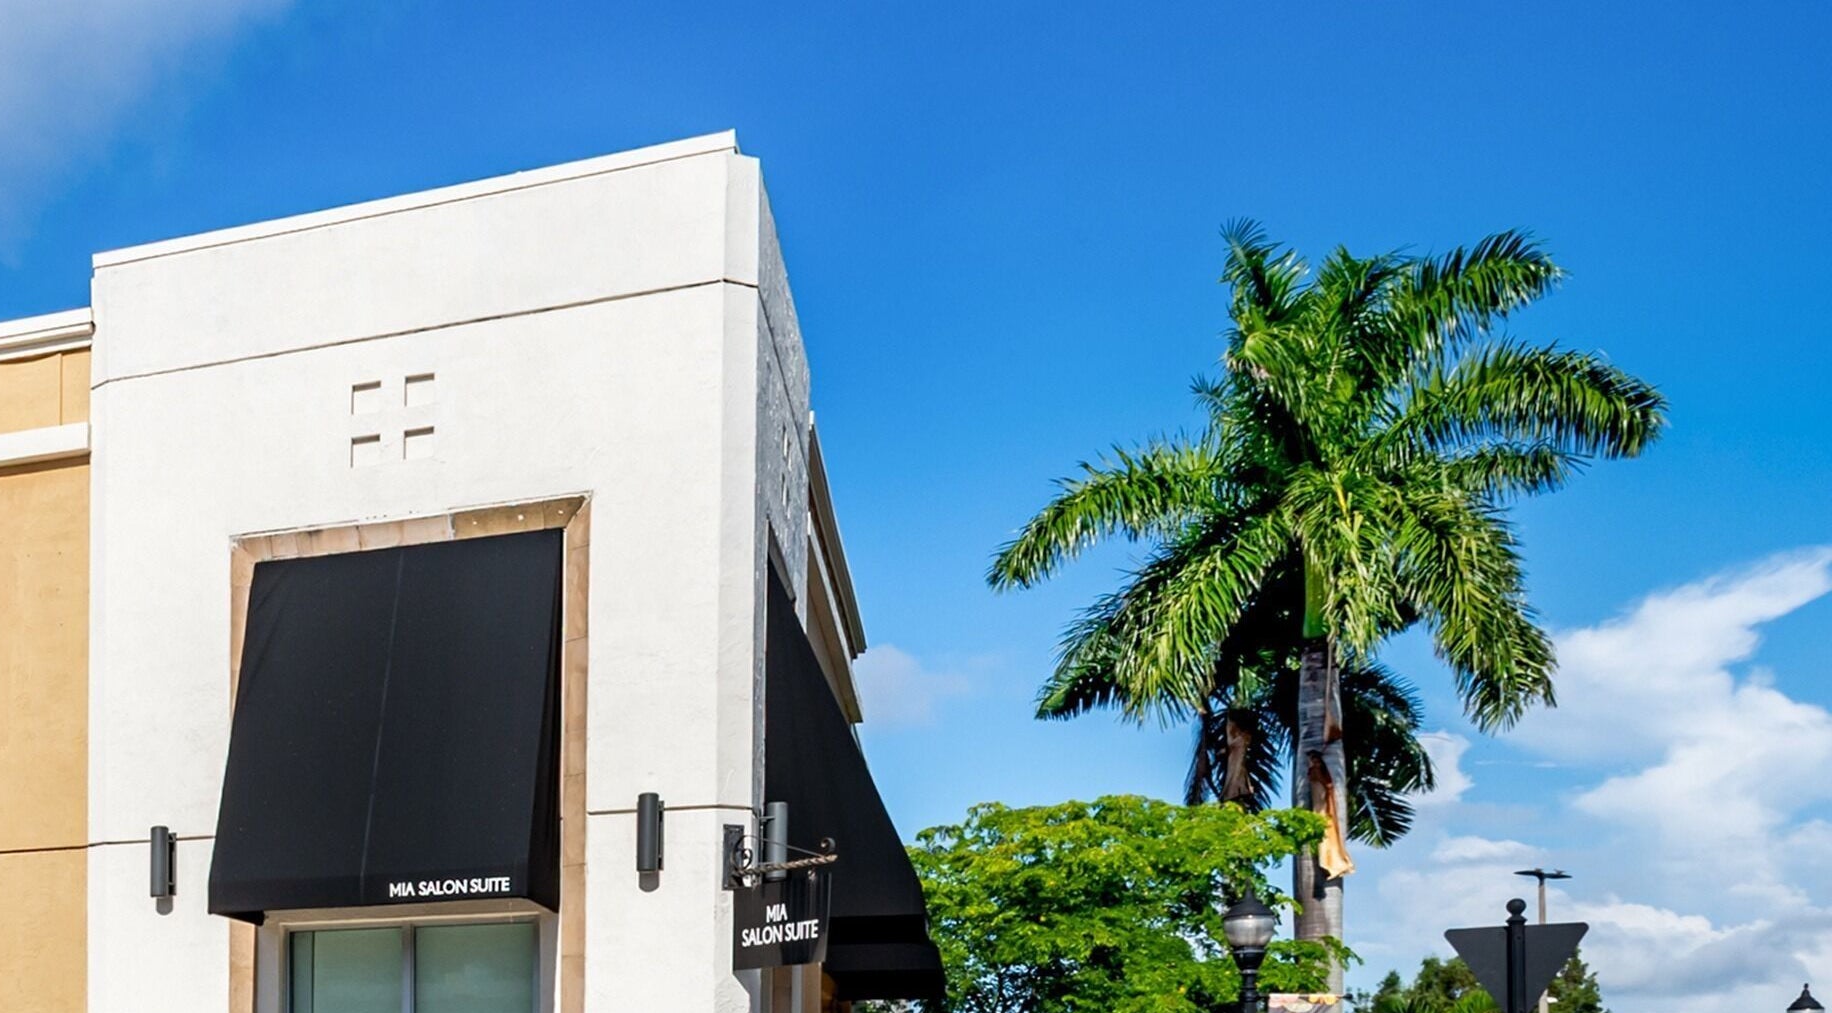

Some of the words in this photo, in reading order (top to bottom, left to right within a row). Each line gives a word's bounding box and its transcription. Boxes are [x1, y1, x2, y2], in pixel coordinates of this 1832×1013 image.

[389, 882, 415, 898] MIA
[418, 879, 468, 896] SALON
[470, 877, 510, 893] SUITE
[766, 903, 788, 923] MIA
[742, 925, 783, 947] SALON
[785, 919, 819, 941] SUITE
